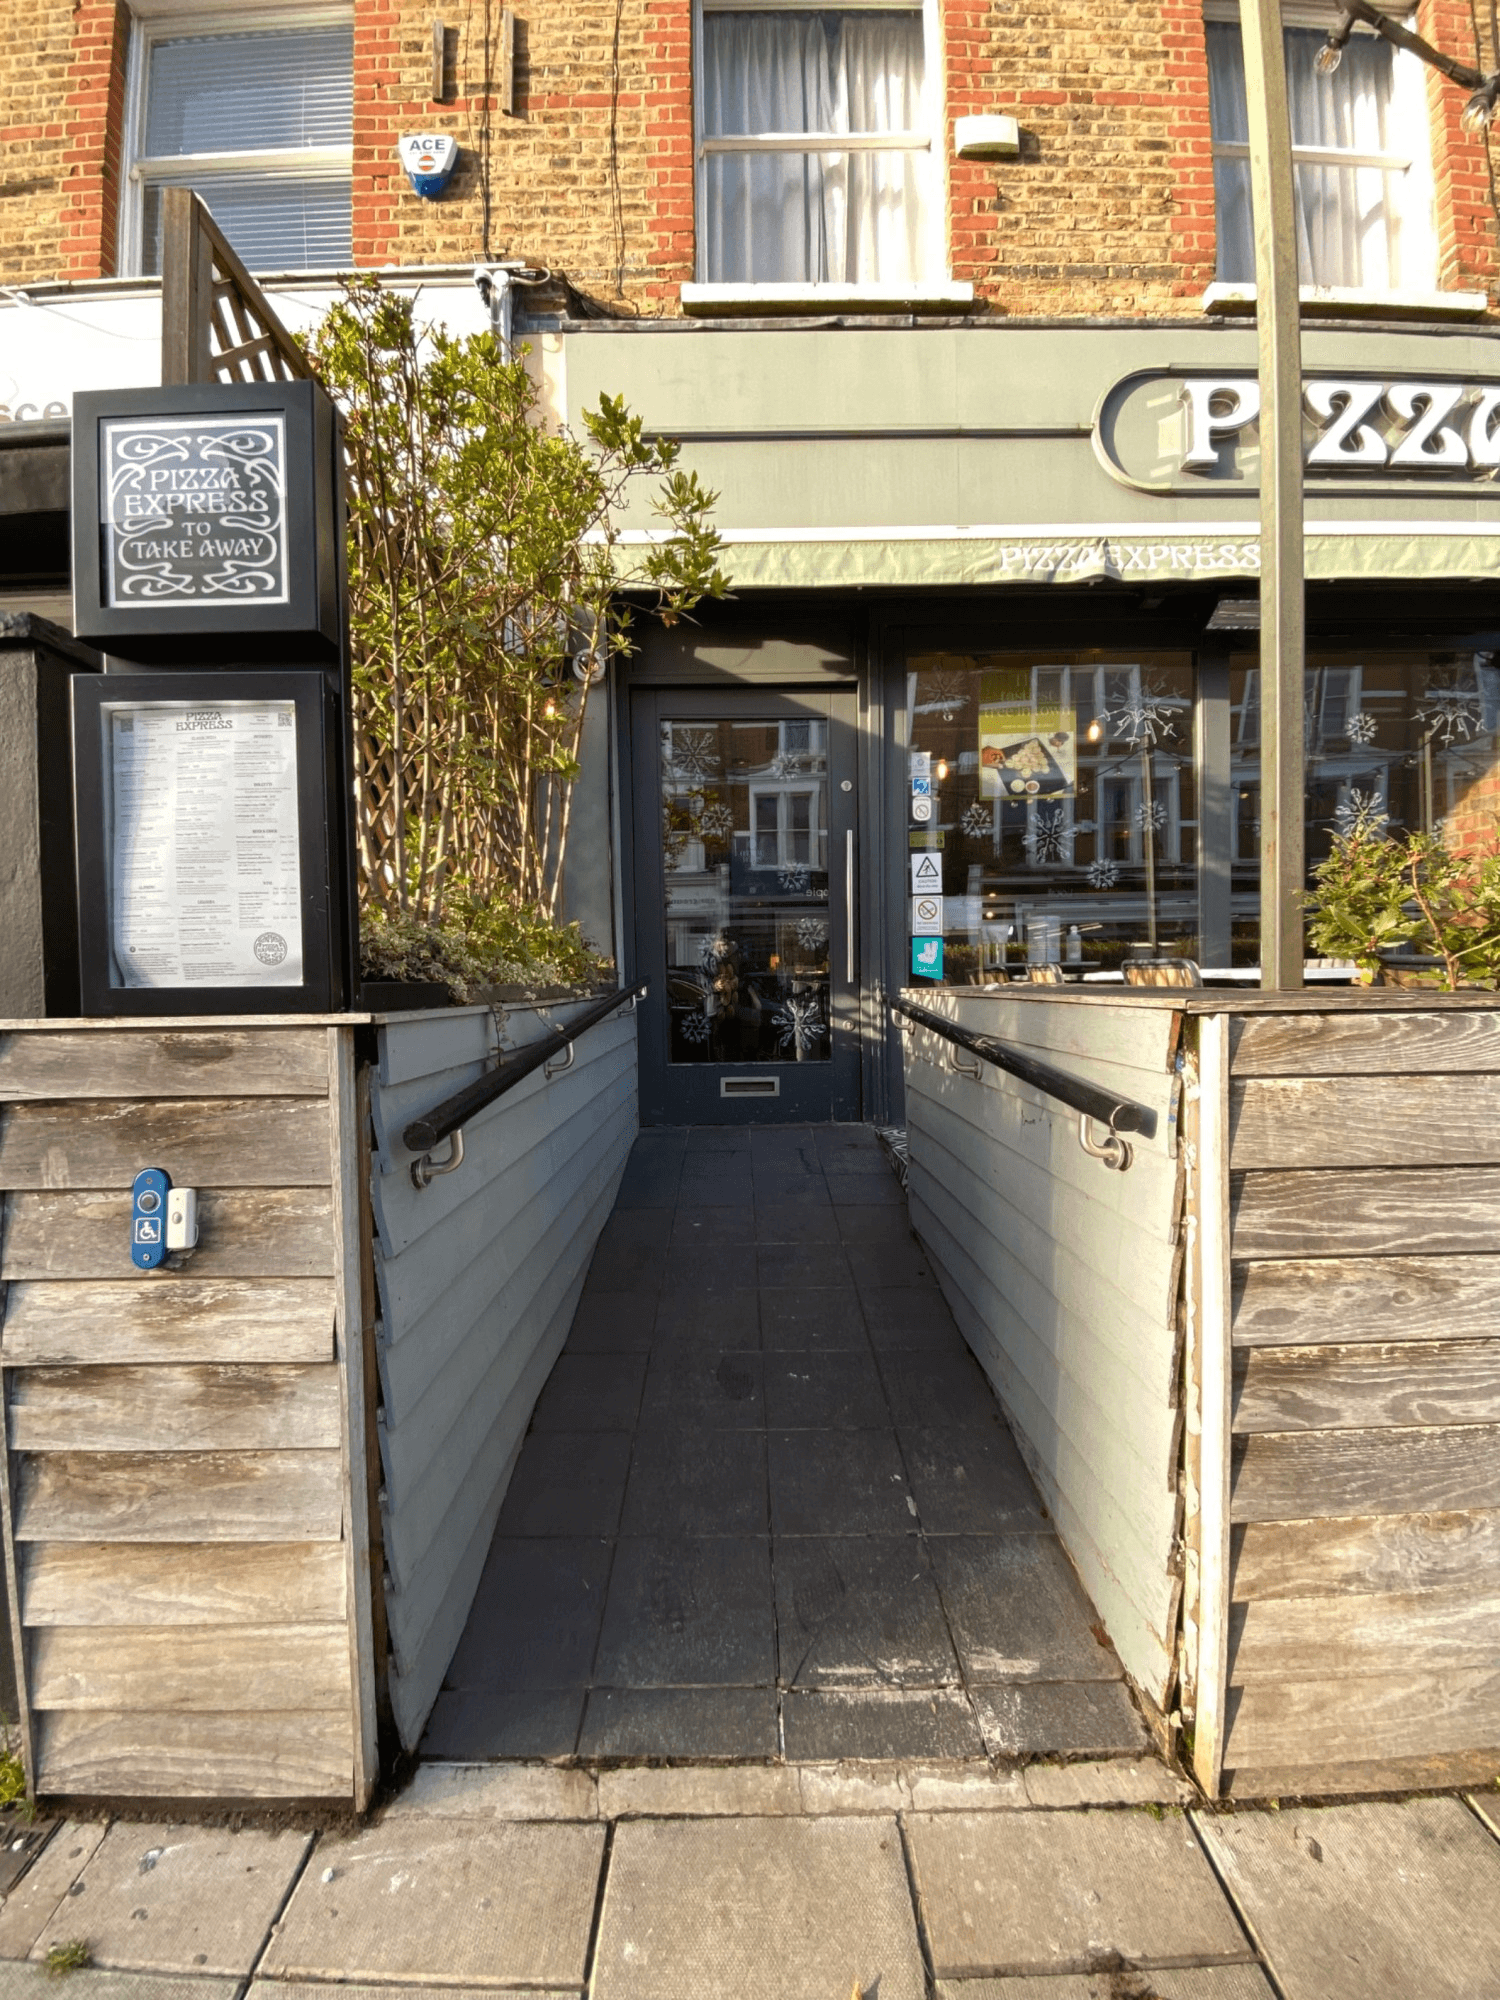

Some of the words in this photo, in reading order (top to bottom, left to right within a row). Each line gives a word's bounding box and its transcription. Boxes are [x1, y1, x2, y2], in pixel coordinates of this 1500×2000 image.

[409, 138, 446, 151] ACE
[1181, 378, 1500, 466] PZZ
[150, 467, 241, 491] PIZZA
[124, 490, 269, 516] EXPRESS
[181, 521, 212, 537] TO
[130, 540, 194, 559] TAKE
[199, 538, 264, 558] AWAY
[176, 720, 233, 731] EXPRESS
[185, 712, 222, 721] PIZZA
